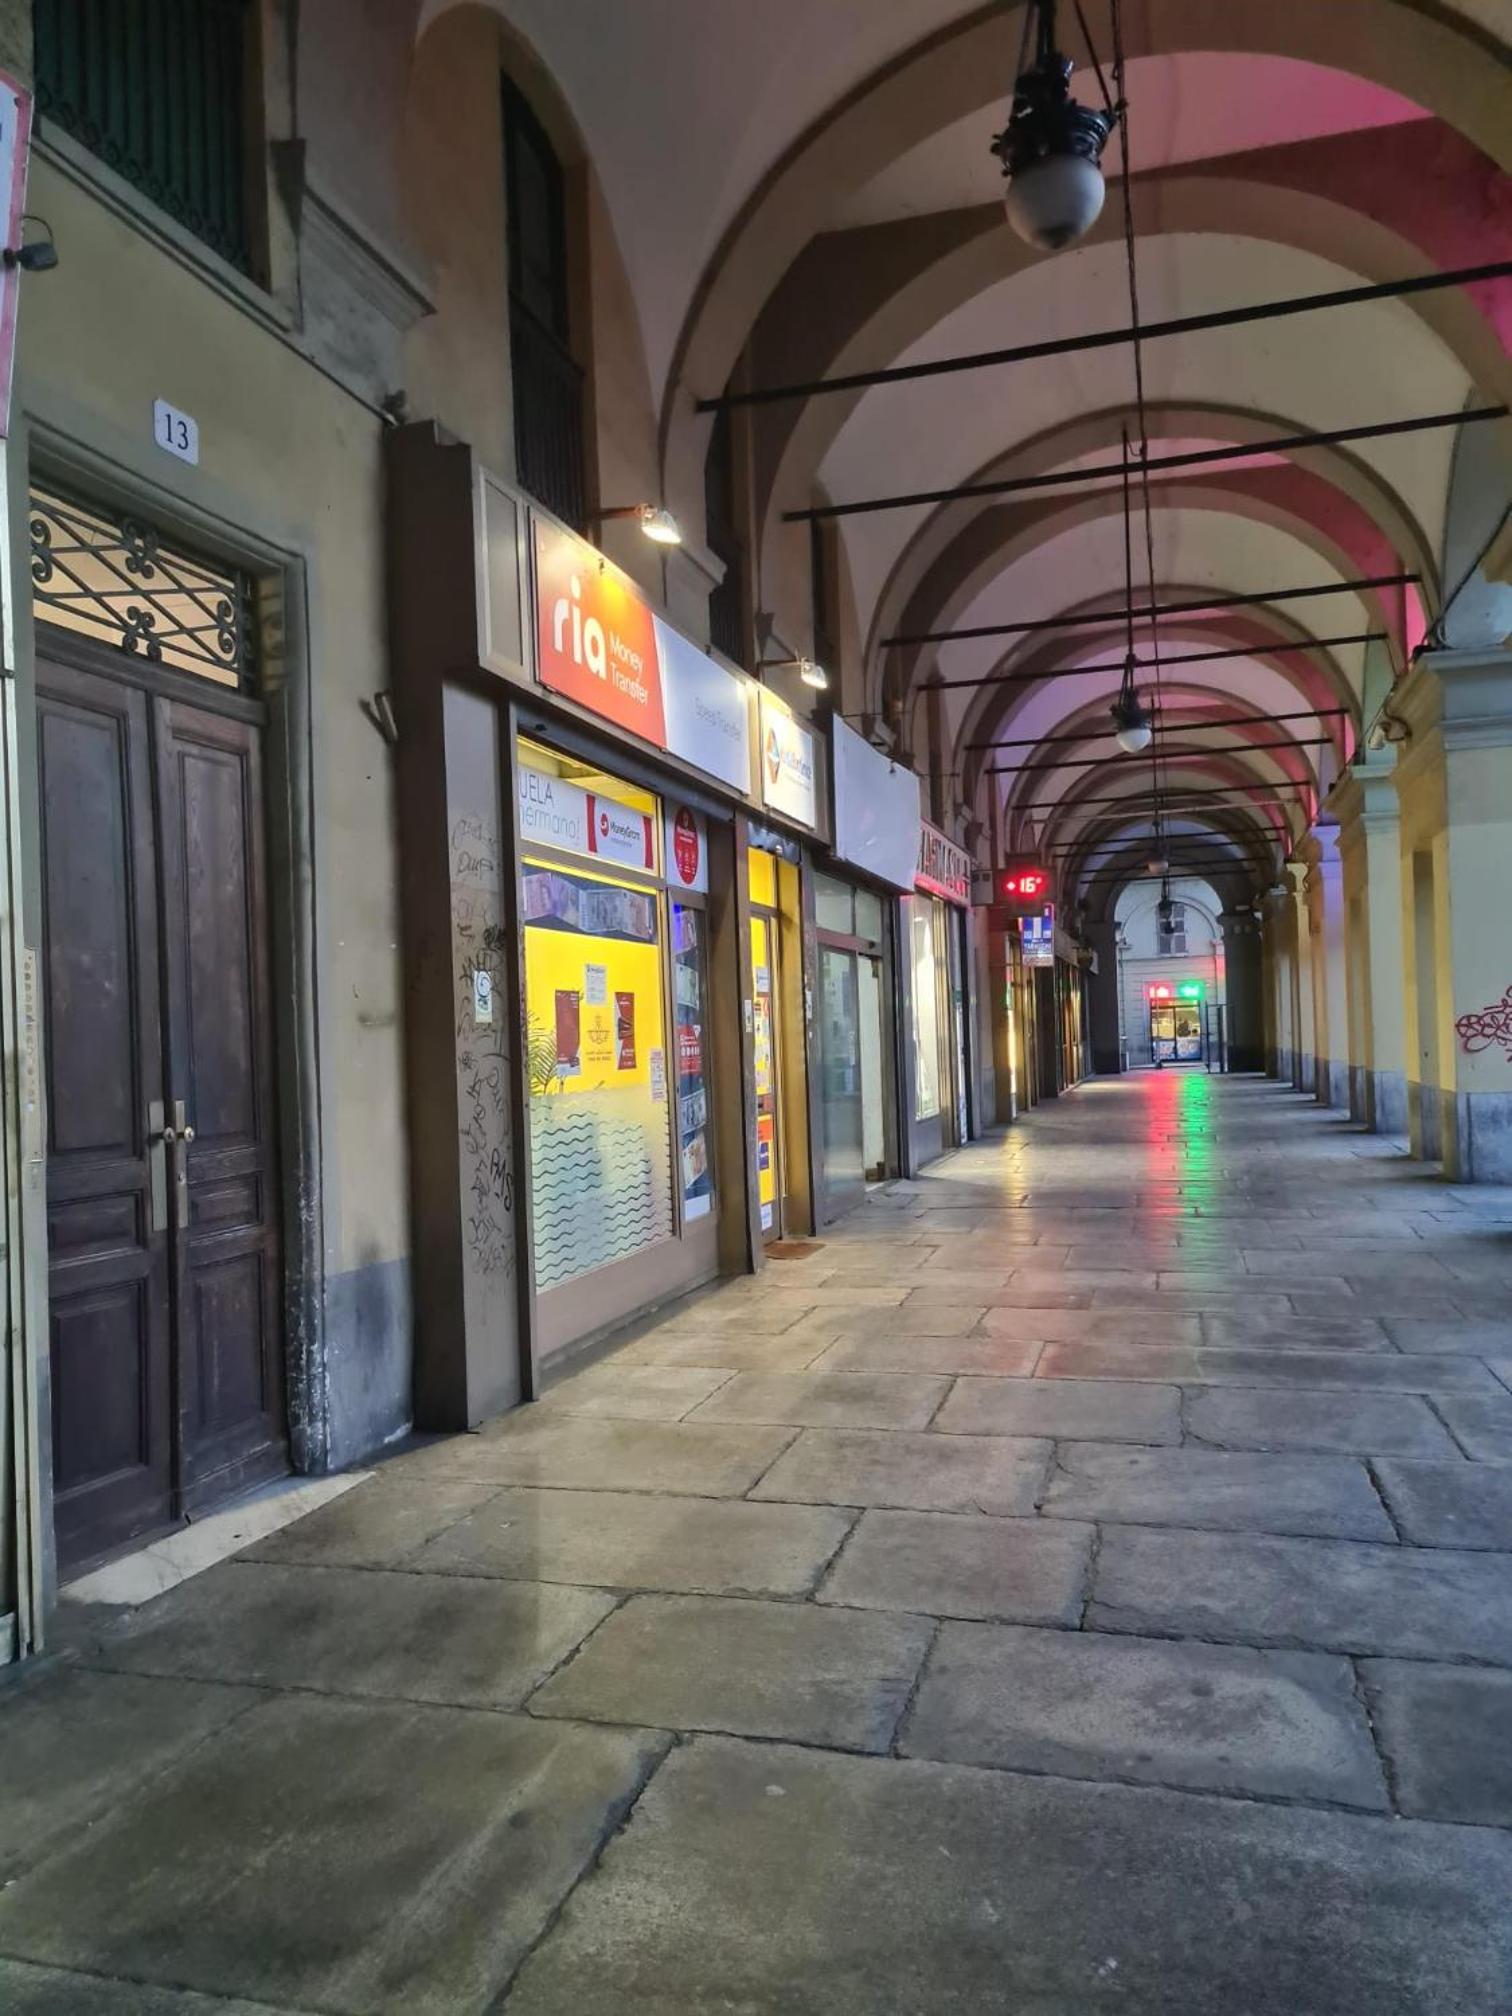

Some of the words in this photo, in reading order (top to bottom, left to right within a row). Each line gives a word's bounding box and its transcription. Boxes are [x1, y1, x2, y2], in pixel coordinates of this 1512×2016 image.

[165, 413, 189, 450] 13
[552, 573, 607, 681] ria
[610, 632, 644, 681] Money
[610, 661, 649, 706] Transfer
